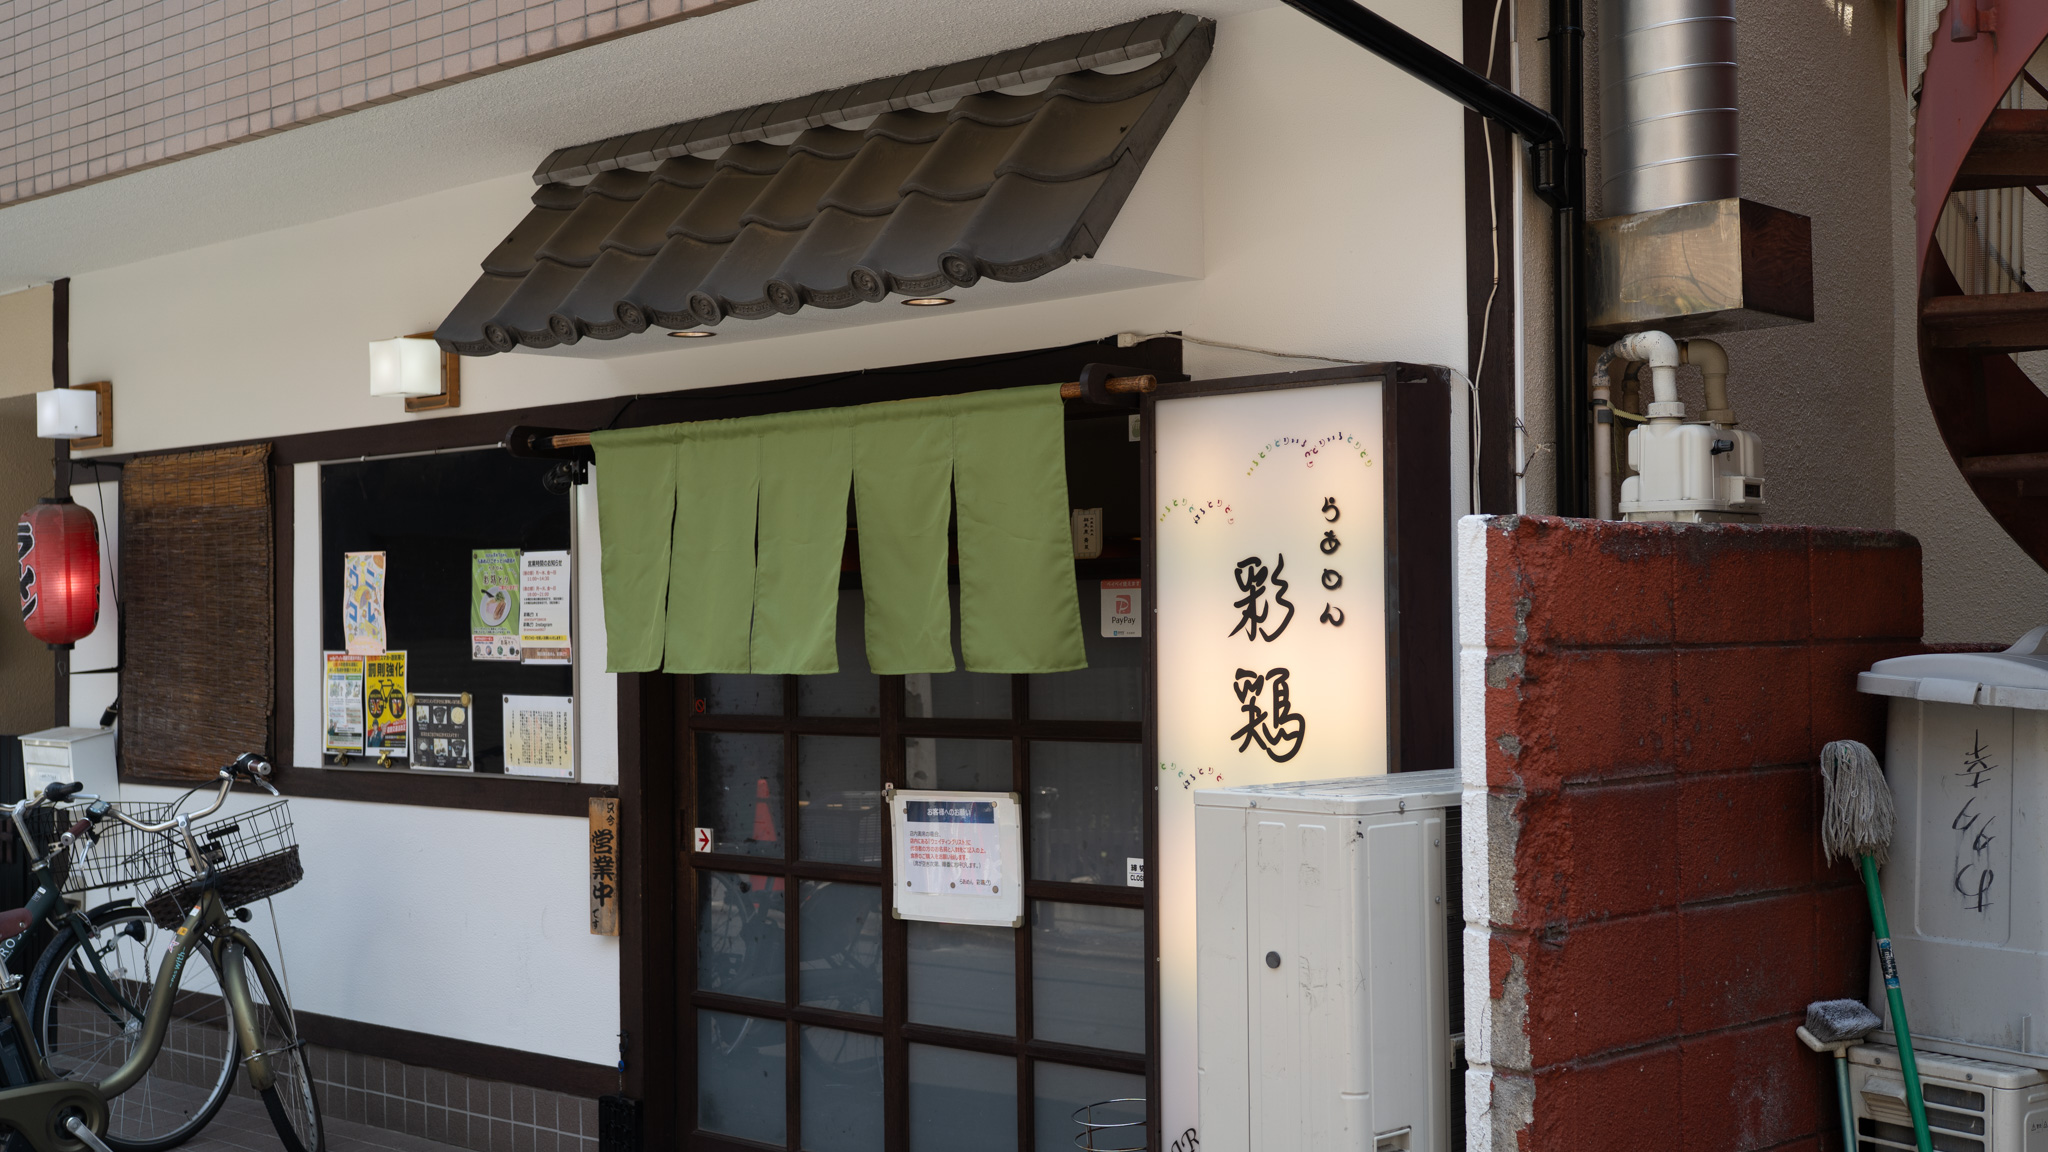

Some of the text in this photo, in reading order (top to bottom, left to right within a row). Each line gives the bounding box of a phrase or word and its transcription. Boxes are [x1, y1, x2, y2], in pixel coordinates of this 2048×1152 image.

[1320, 496, 1345, 627] らあめん
[1111, 616, 1136, 625] PayPay
[368, 662, 404, 678] 罰則強化
[606, 802, 615, 826] 只今
[927, 808, 972, 817] お客様へのお願い
[592, 828, 615, 908] 営業中
[174, 950, 186, 970] with
